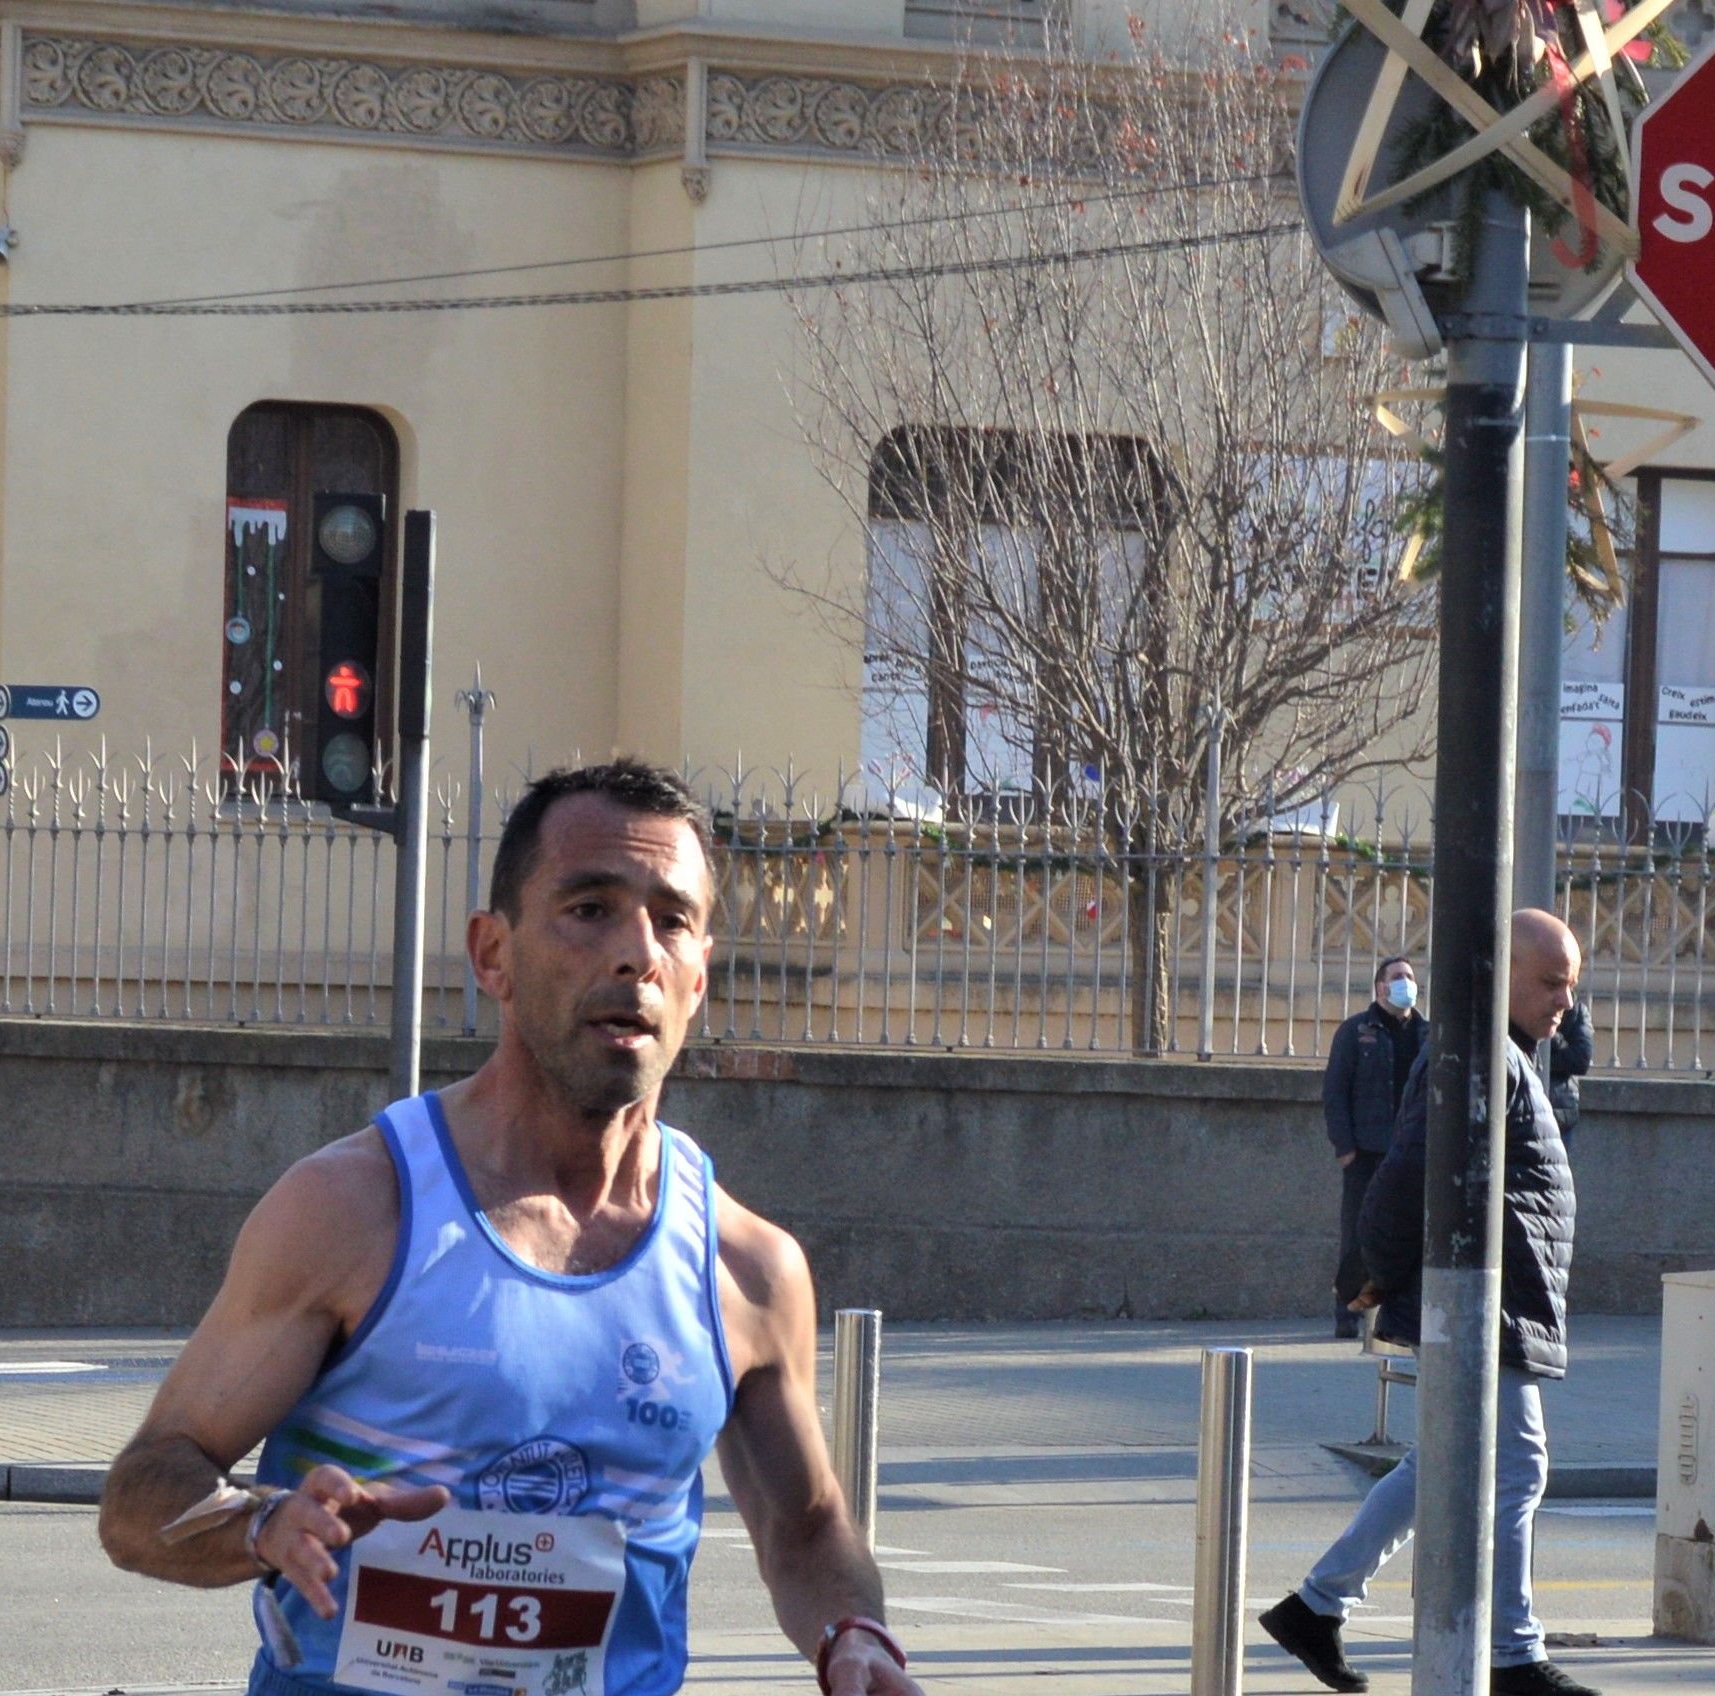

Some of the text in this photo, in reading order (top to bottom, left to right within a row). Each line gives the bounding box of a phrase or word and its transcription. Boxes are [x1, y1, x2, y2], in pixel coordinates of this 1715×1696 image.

[1662, 686, 1685, 700] Creix
[626, 1397, 679, 1430] 100
[469, 1563, 566, 1585] laboratories
[430, 1589, 542, 1643] 113
